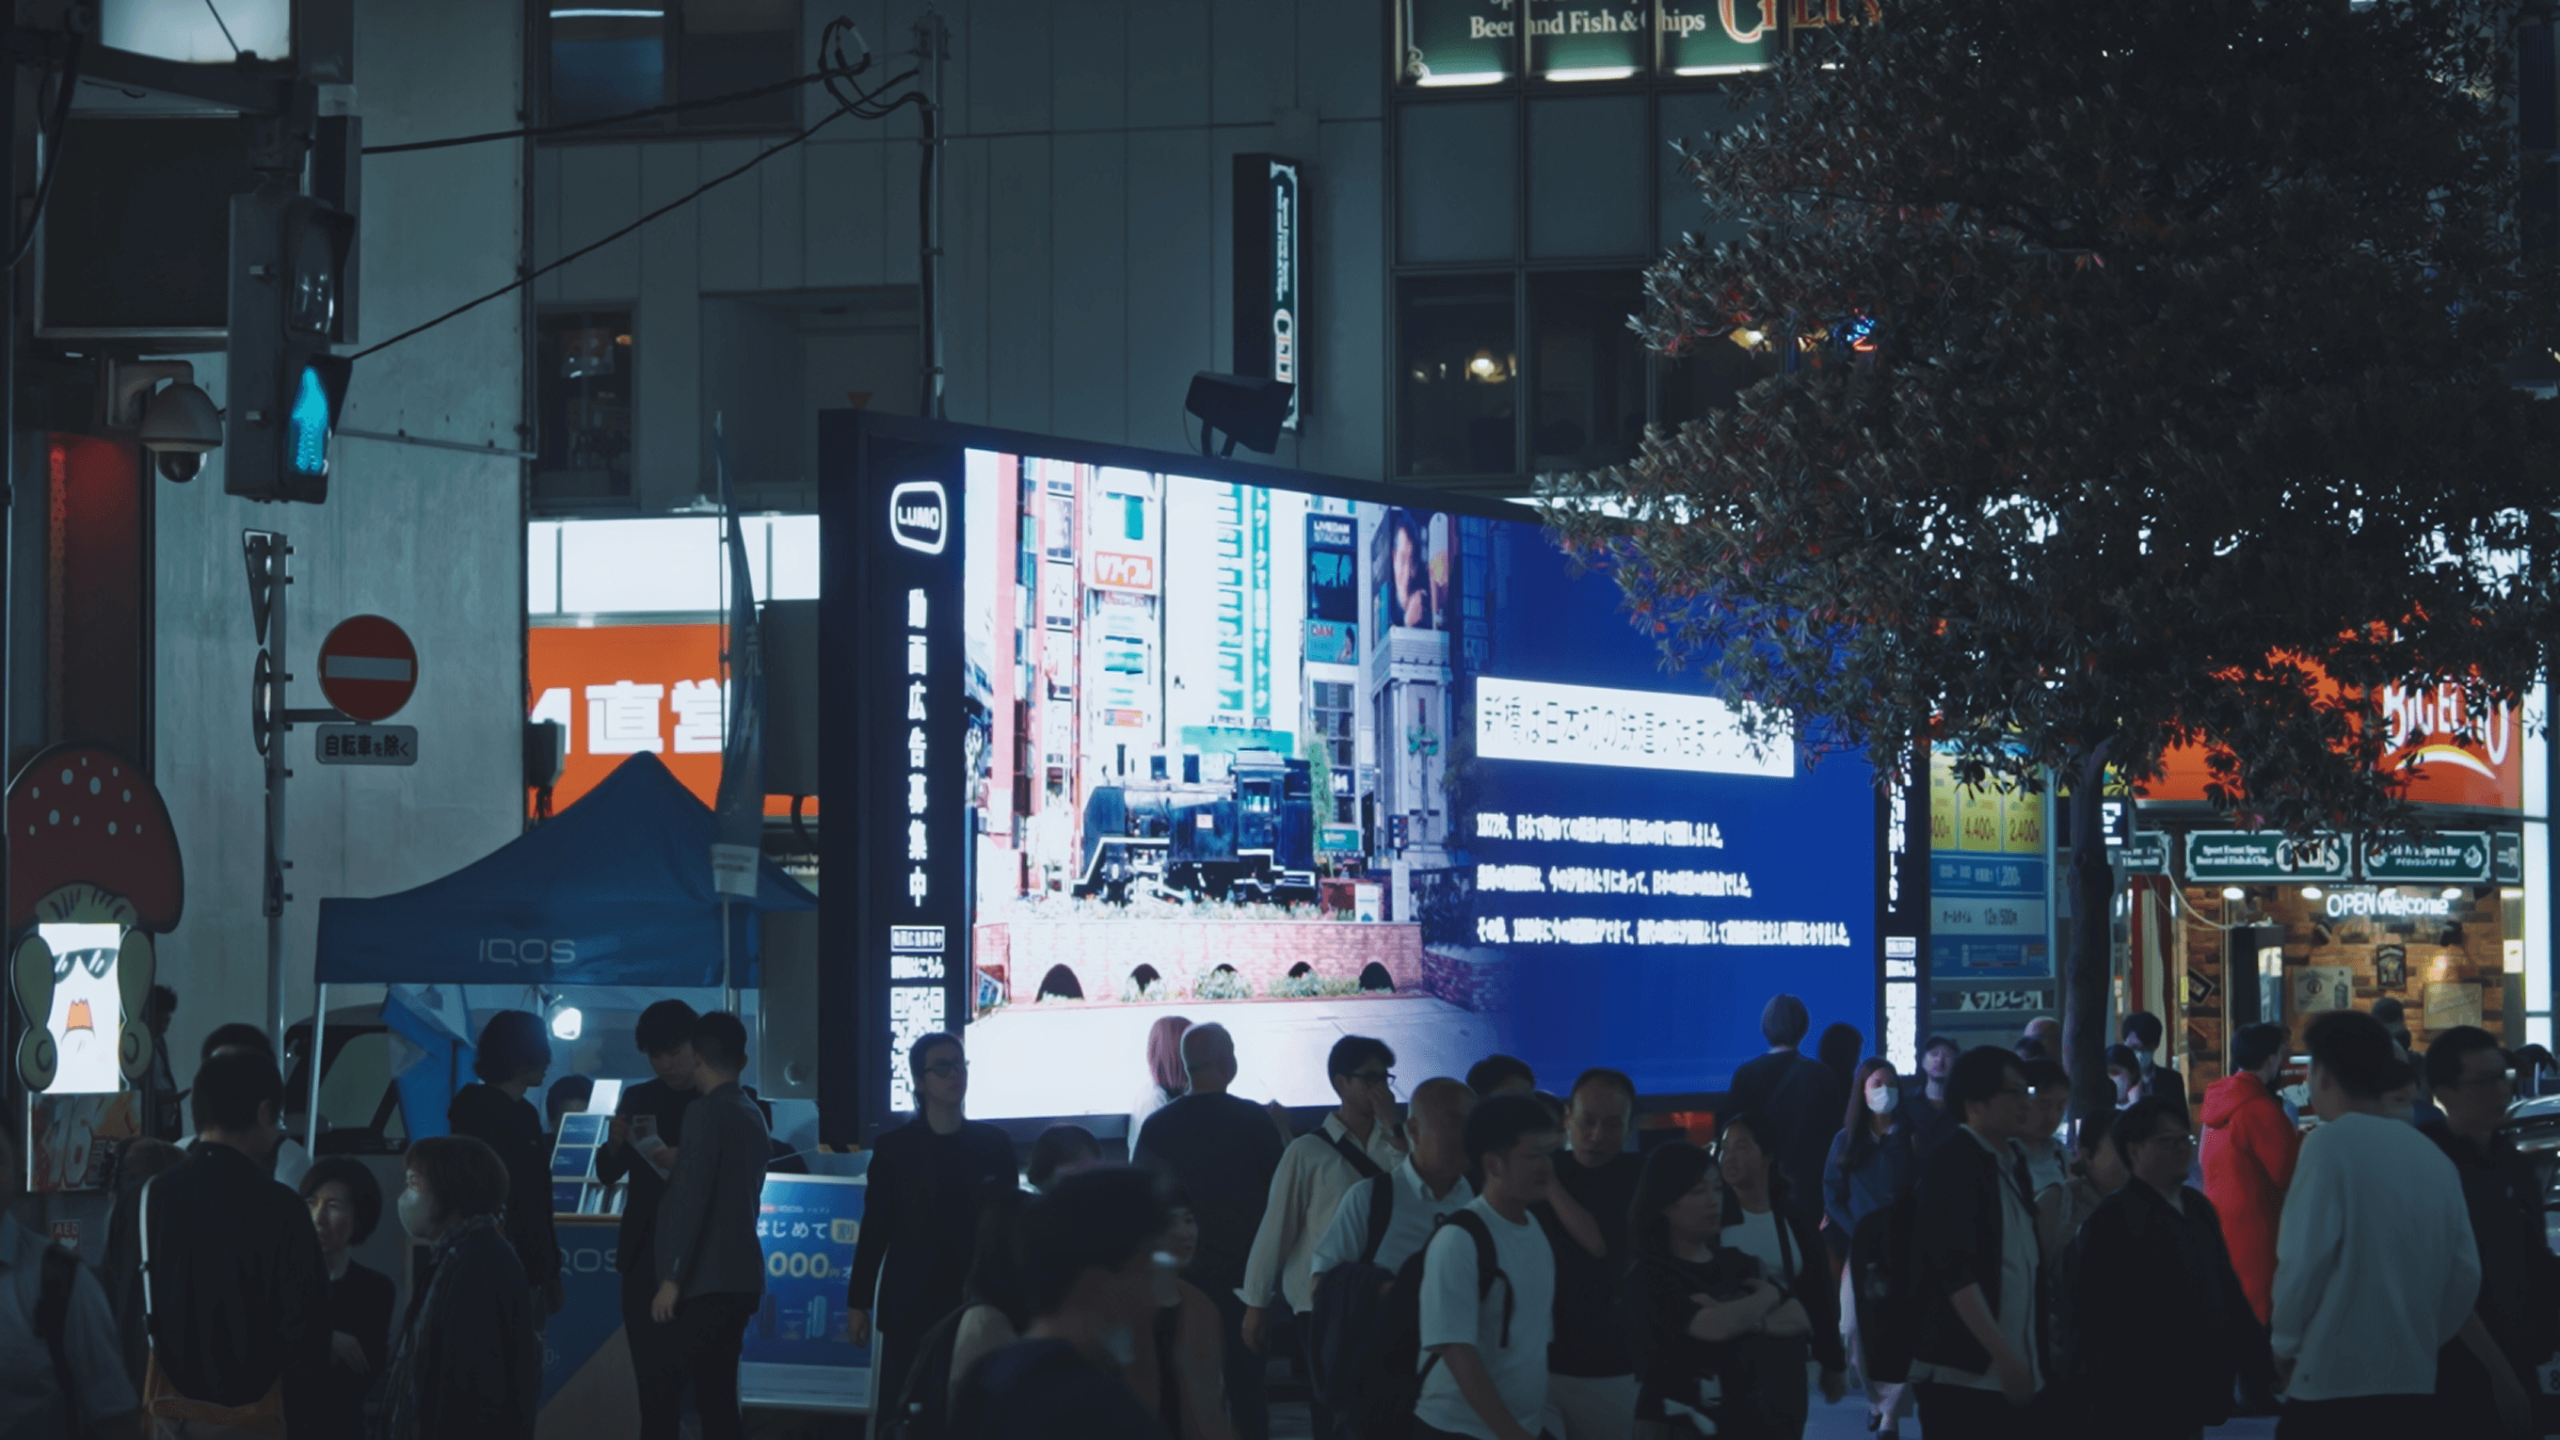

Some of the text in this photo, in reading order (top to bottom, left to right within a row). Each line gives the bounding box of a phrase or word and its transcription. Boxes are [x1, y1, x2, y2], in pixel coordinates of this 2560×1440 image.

[1569, 9, 1618, 34] Fish
[1620, 10, 1638, 32] &
[1641, 9, 1706, 38] hips
[897, 506, 940, 531] LUMO
[325, 734, 410, 757] 自転車を除く
[2326, 892, 2449, 918] OPEN Welcome
[479, 938, 577, 967] IQOS
[54, 1223, 79, 1235] AED
